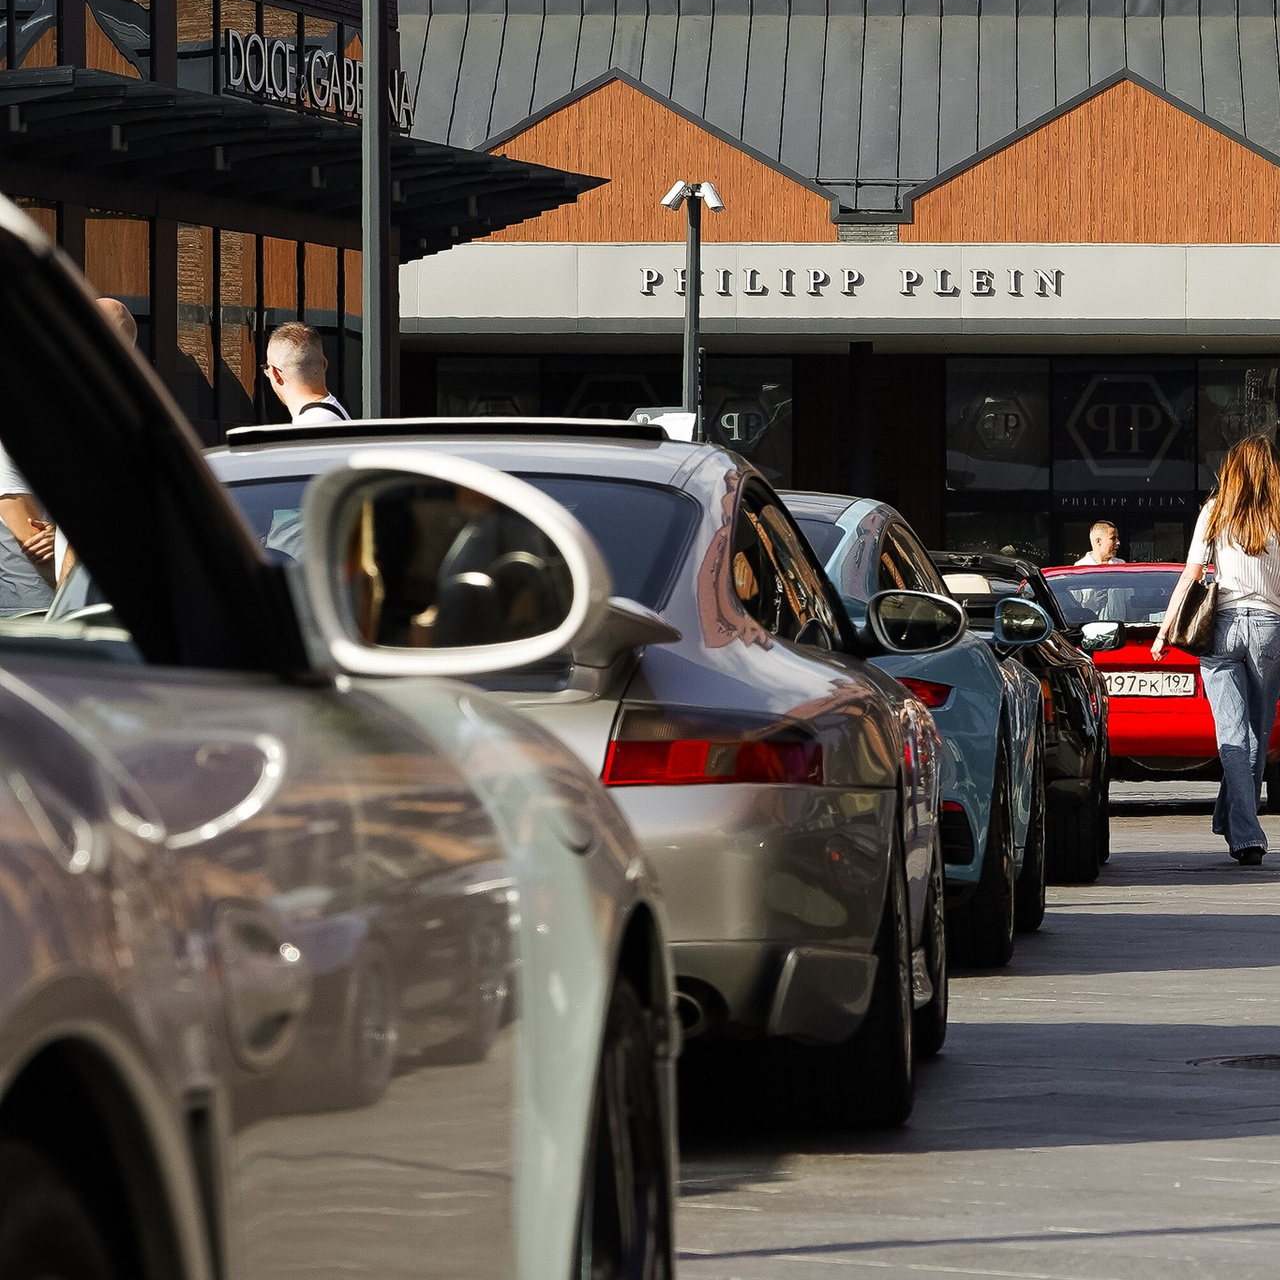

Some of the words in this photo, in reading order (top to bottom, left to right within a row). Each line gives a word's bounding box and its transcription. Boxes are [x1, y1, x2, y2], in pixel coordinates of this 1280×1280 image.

[227, 28, 297, 98] DOLCE
[297, 74, 308, 101] &
[307, 49, 414, 126] GABBNA
[898, 268, 1066, 297] PLEIN
[1061, 497, 1128, 506] PHILIPP
[1138, 497, 1186, 506] PLEIN
[1105, 675, 1160, 693] 197PK
[1164, 675, 1190, 688] 197
